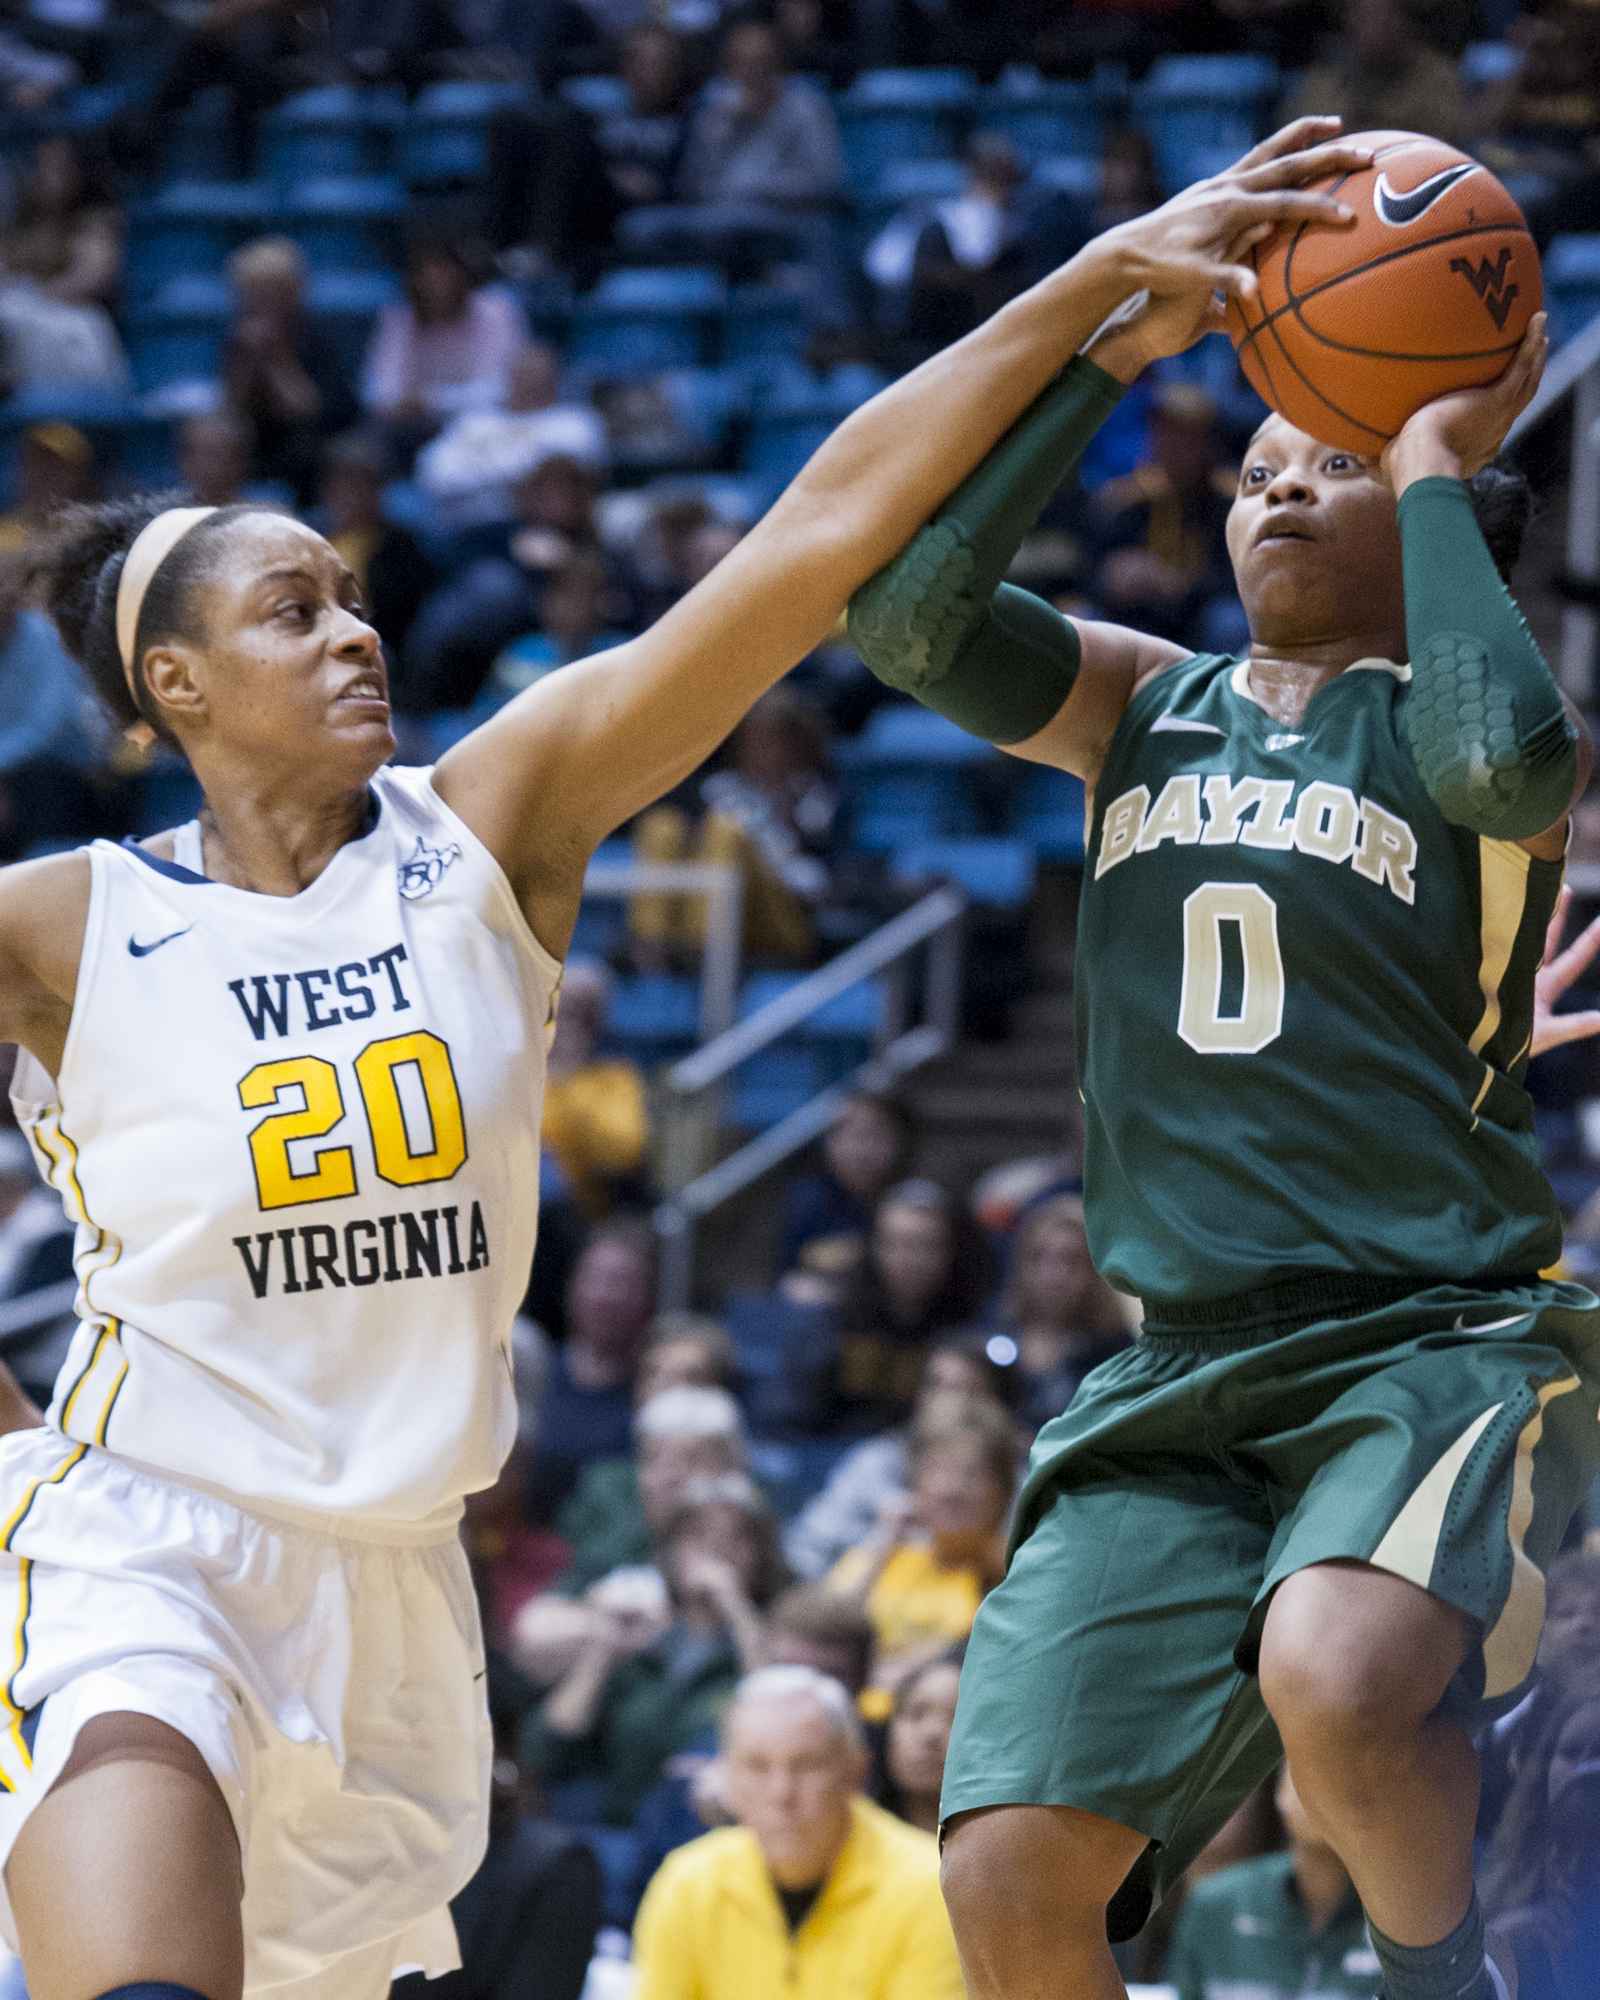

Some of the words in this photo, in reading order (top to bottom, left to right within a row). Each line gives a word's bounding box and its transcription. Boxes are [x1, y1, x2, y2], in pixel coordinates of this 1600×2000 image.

[1095, 774, 1417, 905] BAYLOR
[228, 942, 410, 1040] WEST
[1177, 881, 1285, 1054] 0
[237, 1029, 468, 1211] 20
[232, 1200, 489, 1298] VIRGINIA
